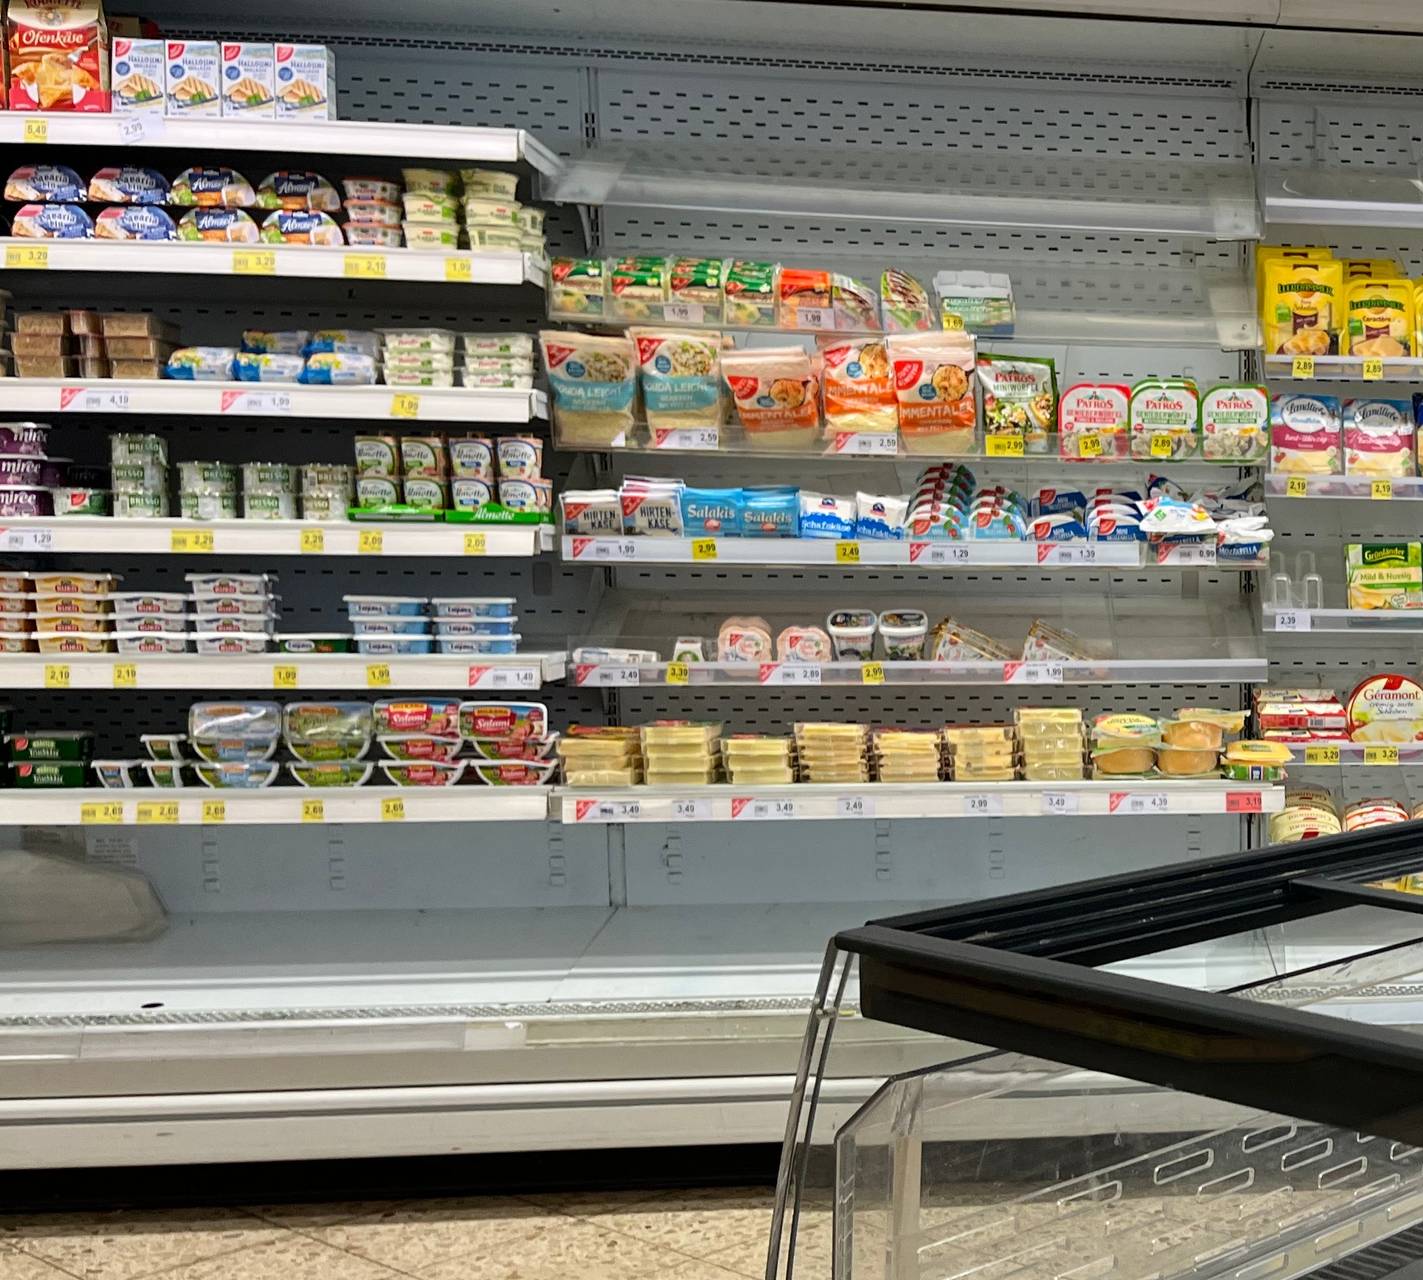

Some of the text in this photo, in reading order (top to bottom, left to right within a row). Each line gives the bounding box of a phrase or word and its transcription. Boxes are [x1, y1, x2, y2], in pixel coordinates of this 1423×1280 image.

[22, 30, 84, 48] Ofenkäse
[1296, 361, 1313, 370] 2,89
[1366, 364, 1381, 373] 2,89
[1077, 398, 1114, 409] PATROS
[1146, 399, 1183, 410] PATROS
[1217, 399, 1253, 409] PATROS
[1288, 401, 1327, 416] Landliebe
[1359, 405, 1399, 421] Landliebe
[700, 433, 717, 442] 2,59
[1007, 441, 1023, 450] 2,99
[1154, 439, 1170, 448] 2,89
[1290, 481, 1306, 490] 2,19
[1375, 484, 1391, 493] 2,19
[472, 507, 515, 521] Almette
[640, 506, 675, 518] HIRTEN-
[688, 505, 735, 518] Salakis
[744, 511, 792, 523] Salakis
[1080, 550, 1095, 559] 1,39
[1360, 571, 1377, 581] Mild
[1280, 616, 1296, 625] 2,39
[1363, 688, 1421, 701] Géramont
[393, 713, 427, 726] Salami
[478, 717, 511, 730] Salami
[1151, 798, 1168, 808] 4,39
